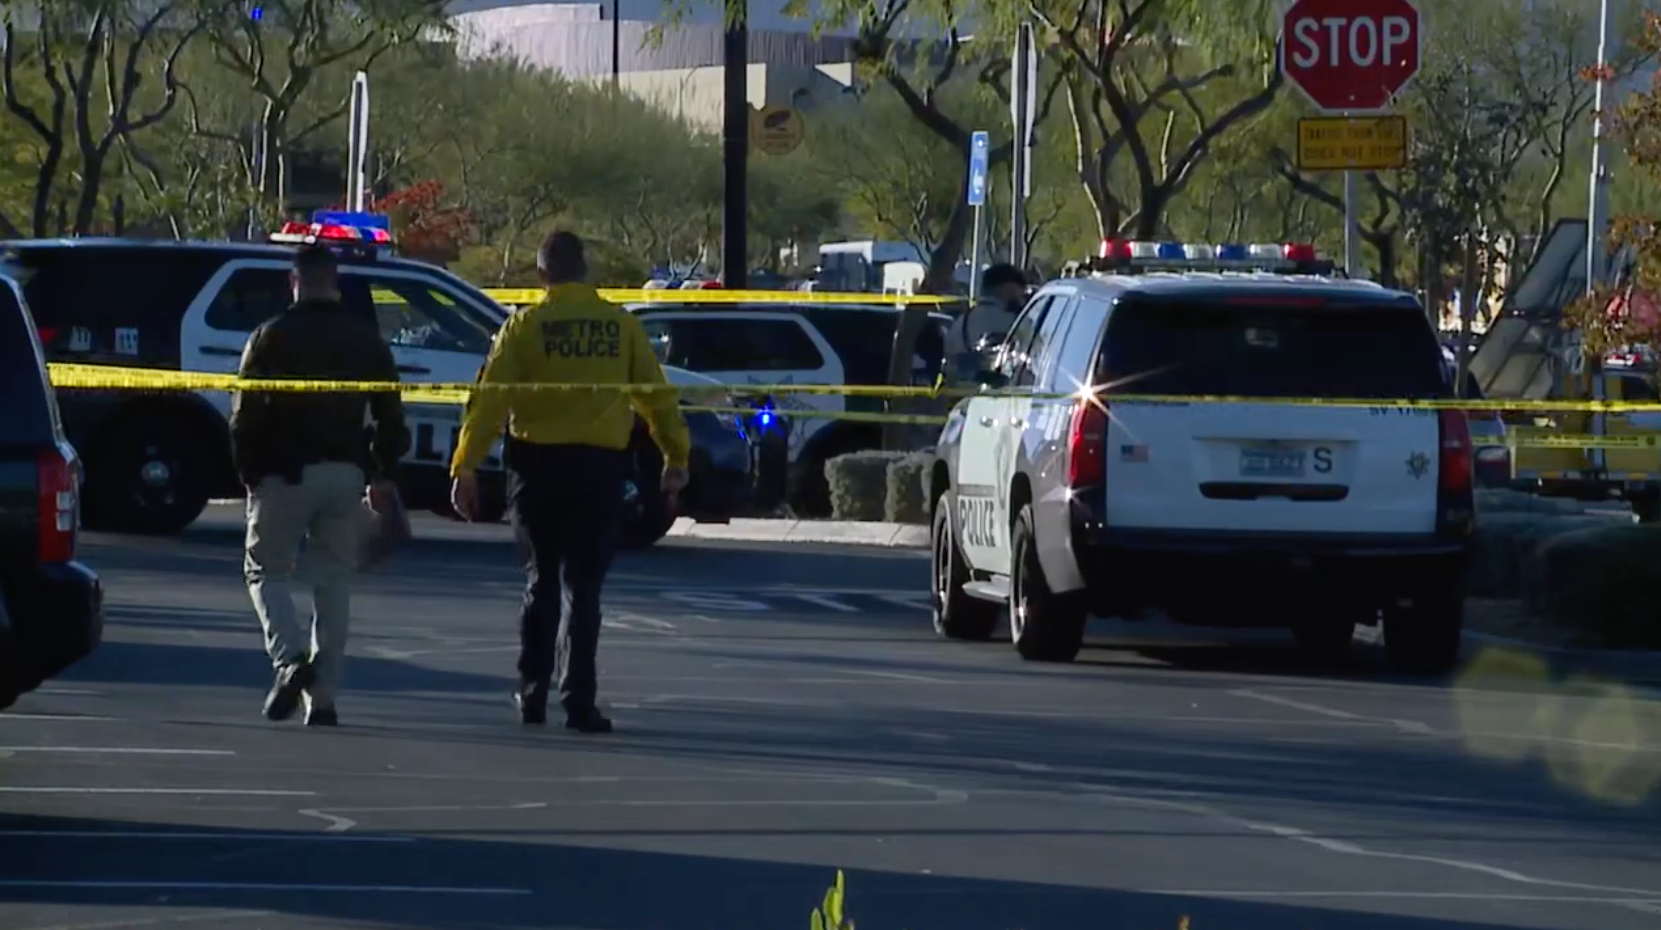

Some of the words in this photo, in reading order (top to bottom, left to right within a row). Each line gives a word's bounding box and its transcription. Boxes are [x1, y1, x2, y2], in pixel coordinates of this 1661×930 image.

[1293, 16, 1410, 68] STOP
[541, 320, 620, 338] METRO
[544, 339, 620, 358] POLICE
[1313, 446, 1332, 474] S
[958, 499, 996, 547] POLICE
